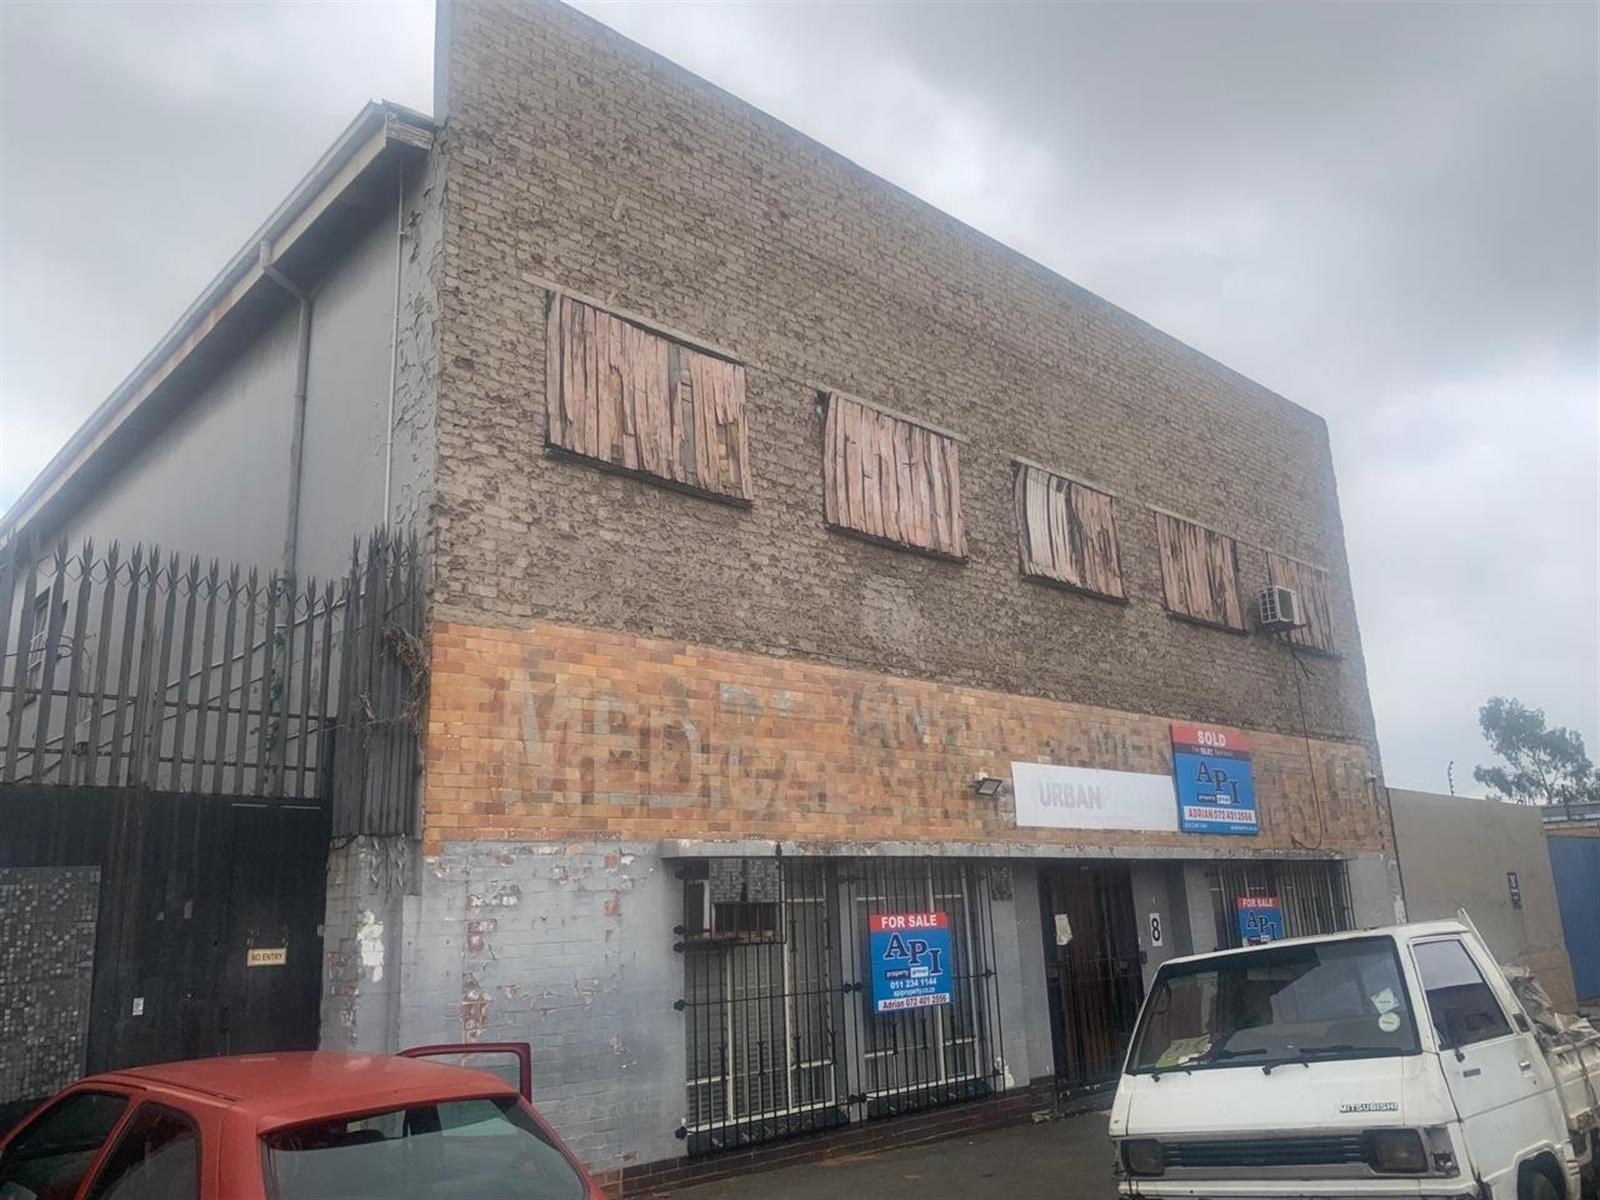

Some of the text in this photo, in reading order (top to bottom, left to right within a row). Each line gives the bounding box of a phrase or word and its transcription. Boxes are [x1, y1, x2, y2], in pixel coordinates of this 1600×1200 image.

[1197, 730, 1226, 746] SOLD
[1195, 759, 1240, 804] API
[1039, 781, 1103, 810] URBAN
[1242, 898, 1273, 908] FOR SALE
[881, 914, 938, 929] FOR SALE
[1151, 917, 1161, 942] 8
[251, 952, 283, 961] NO ENTRY
[882, 932, 944, 977] API
[890, 977, 937, 990] 011 234 1144
[883, 1000, 905, 1009] Adrian
[1339, 1102, 1399, 1113] MITSUBISHI
